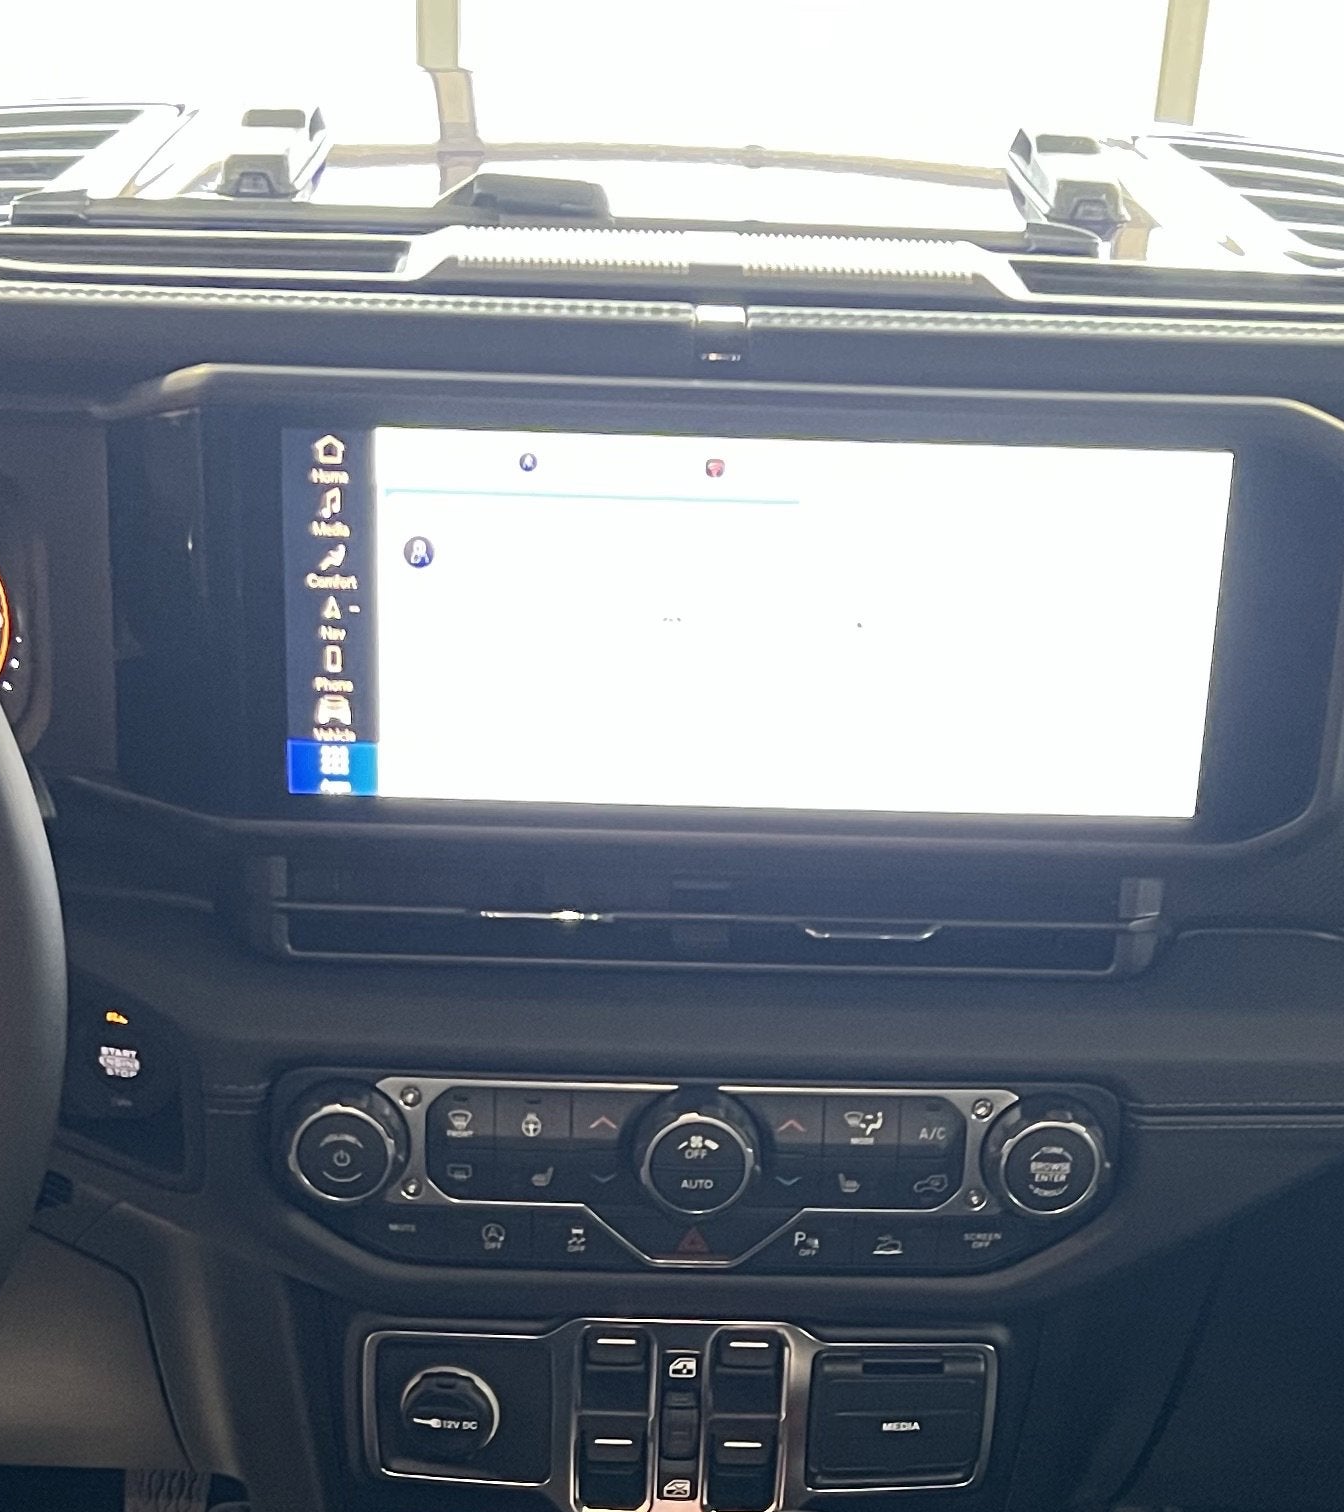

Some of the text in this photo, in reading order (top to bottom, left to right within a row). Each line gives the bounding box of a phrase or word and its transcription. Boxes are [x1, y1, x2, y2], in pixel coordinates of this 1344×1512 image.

[311, 468, 350, 484] Home
[311, 520, 351, 537] Media
[319, 625, 346, 641] Nav
[314, 676, 354, 692] Phone
[919, 1127, 947, 1140] A/C
[685, 1149, 708, 1160] OFF
[1034, 1173, 1067, 1182] ENTER
[681, 1179, 714, 1190] AUTO
[443, 1420, 478, 1430] 12V DC
[881, 1421, 921, 1432] MEDIA
